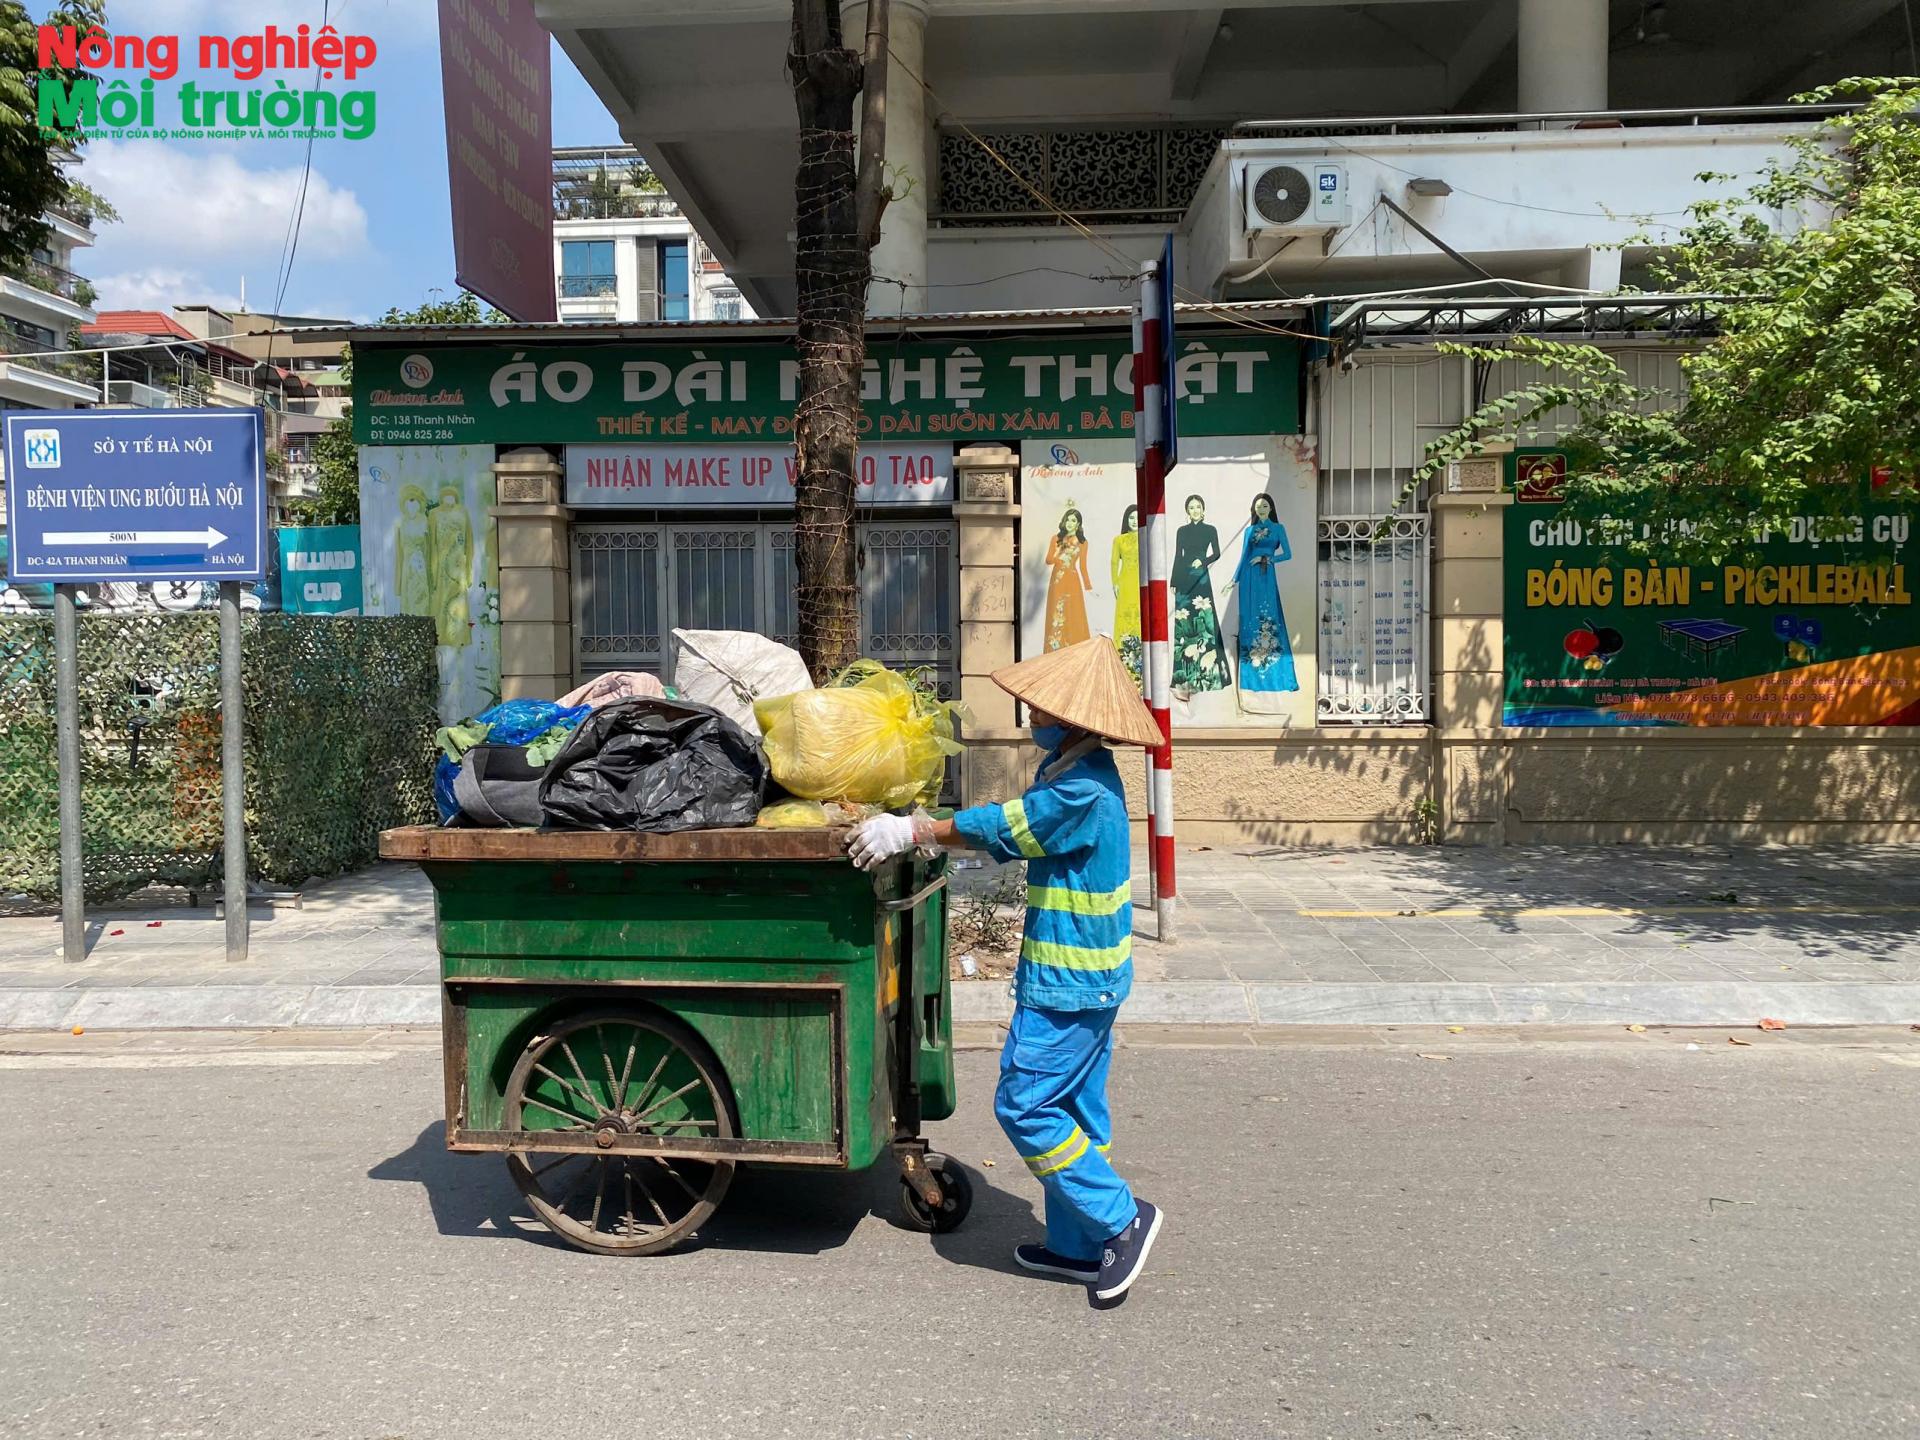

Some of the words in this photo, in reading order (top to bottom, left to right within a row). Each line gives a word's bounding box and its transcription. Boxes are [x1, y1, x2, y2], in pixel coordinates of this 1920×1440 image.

[489, 351, 595, 408] ÁO
[620, 350, 747, 408] DÀI
[371, 415, 389, 425] ĐC:
[394, 415, 411, 425] 138
[413, 415, 445, 425] Thanh
[447, 414, 475, 425] Nhàn
[597, 410, 655, 435] THIẾT
[660, 410, 689, 434] KẾ
[711, 416, 766, 435] MAY
[879, 409, 921, 433] DÀI
[927, 409, 996, 432] SƯỜN
[1002, 407, 1060, 431] XÁM
[1080, 405, 1114, 430] BÀ
[1120, 410, 1135, 429] B
[93, 436, 115, 454] SỞ
[118, 440, 129, 453] Y
[132, 434, 154, 453] TẾ
[157, 436, 180, 453] HÀ
[184, 436, 213, 455] NỘI
[387, 430, 412, 440] 0946
[414, 429, 432, 439] 825
[435, 429, 454, 439] 286
[586, 455, 652, 492] NHẬN
[664, 457, 731, 487] MAKE
[742, 456, 773, 487] UP
[783, 456, 799, 487] V
[889, 455, 934, 488] TẠO
[1077, 466, 1105, 477] Anh
[26, 483, 67, 512] BỆNH
[70, 483, 106, 511] VIỆN
[110, 488, 141, 507] UNG
[144, 481, 186, 507] BƯỚU
[189, 482, 211, 507] HÀ
[215, 481, 243, 510] NỘI
[109, 532, 137, 542] 500M
[1872, 515, 1909, 549] CỤ
[46, 556, 63, 566] 42A
[64, 556, 98, 566] THANH
[100, 553, 128, 566] NHÀN
[211, 552, 226, 564] HÀ
[227, 553, 245, 566] NỘI
[1527, 560, 1613, 607] BÓNG
[1623, 559, 1690, 606] BÀN
[1724, 564, 1911, 606] PICKLEBALL
